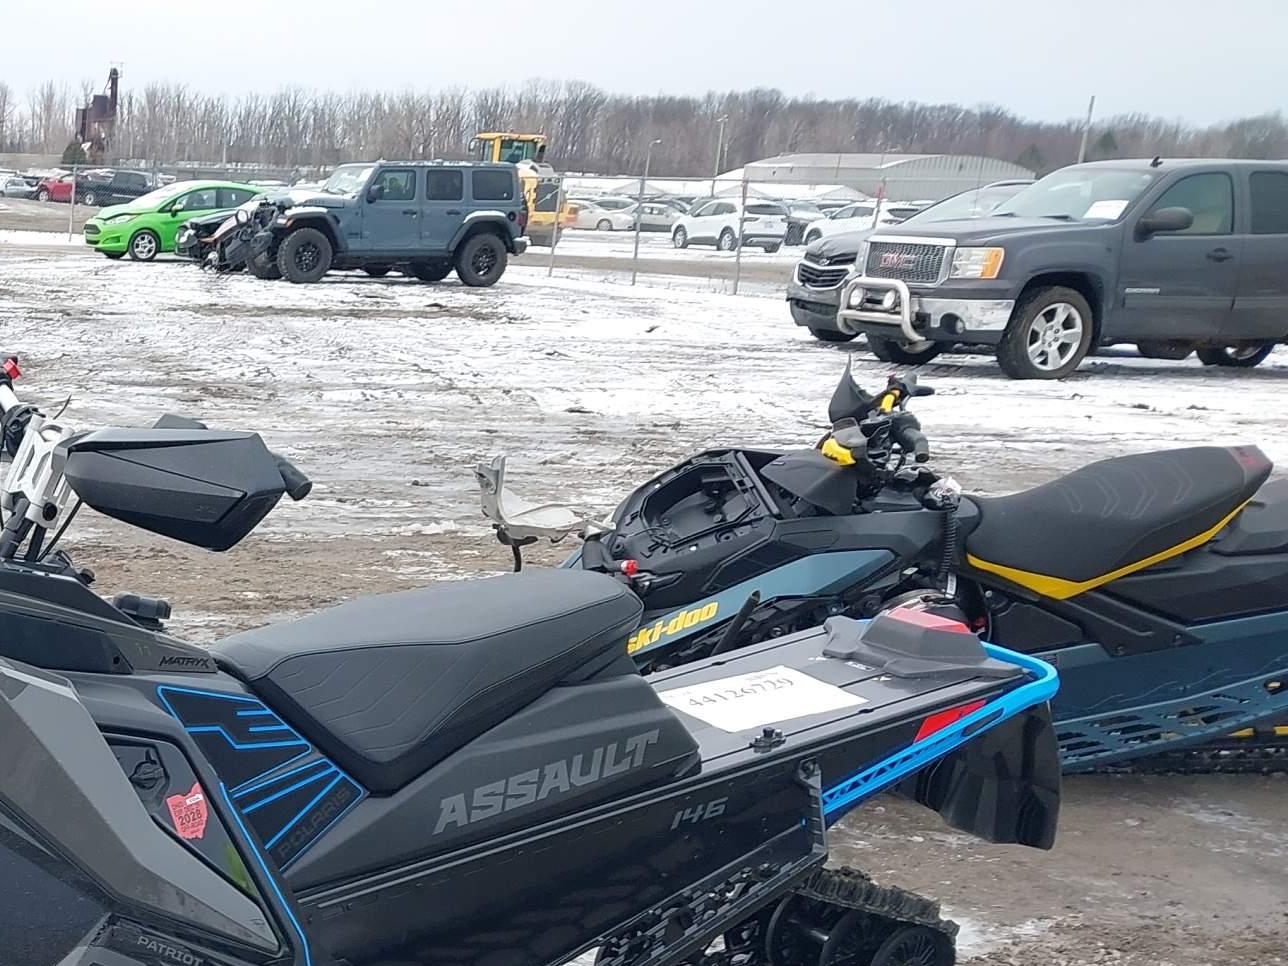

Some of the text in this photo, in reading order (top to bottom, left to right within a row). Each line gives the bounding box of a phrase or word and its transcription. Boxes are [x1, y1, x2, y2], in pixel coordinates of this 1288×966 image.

[688, 677, 795, 708] 44126729
[432, 728, 661, 836] ASSAULT
[178, 809, 202, 826] 2028
[278, 787, 352, 858] POLARIS
[670, 796, 729, 831] 146
